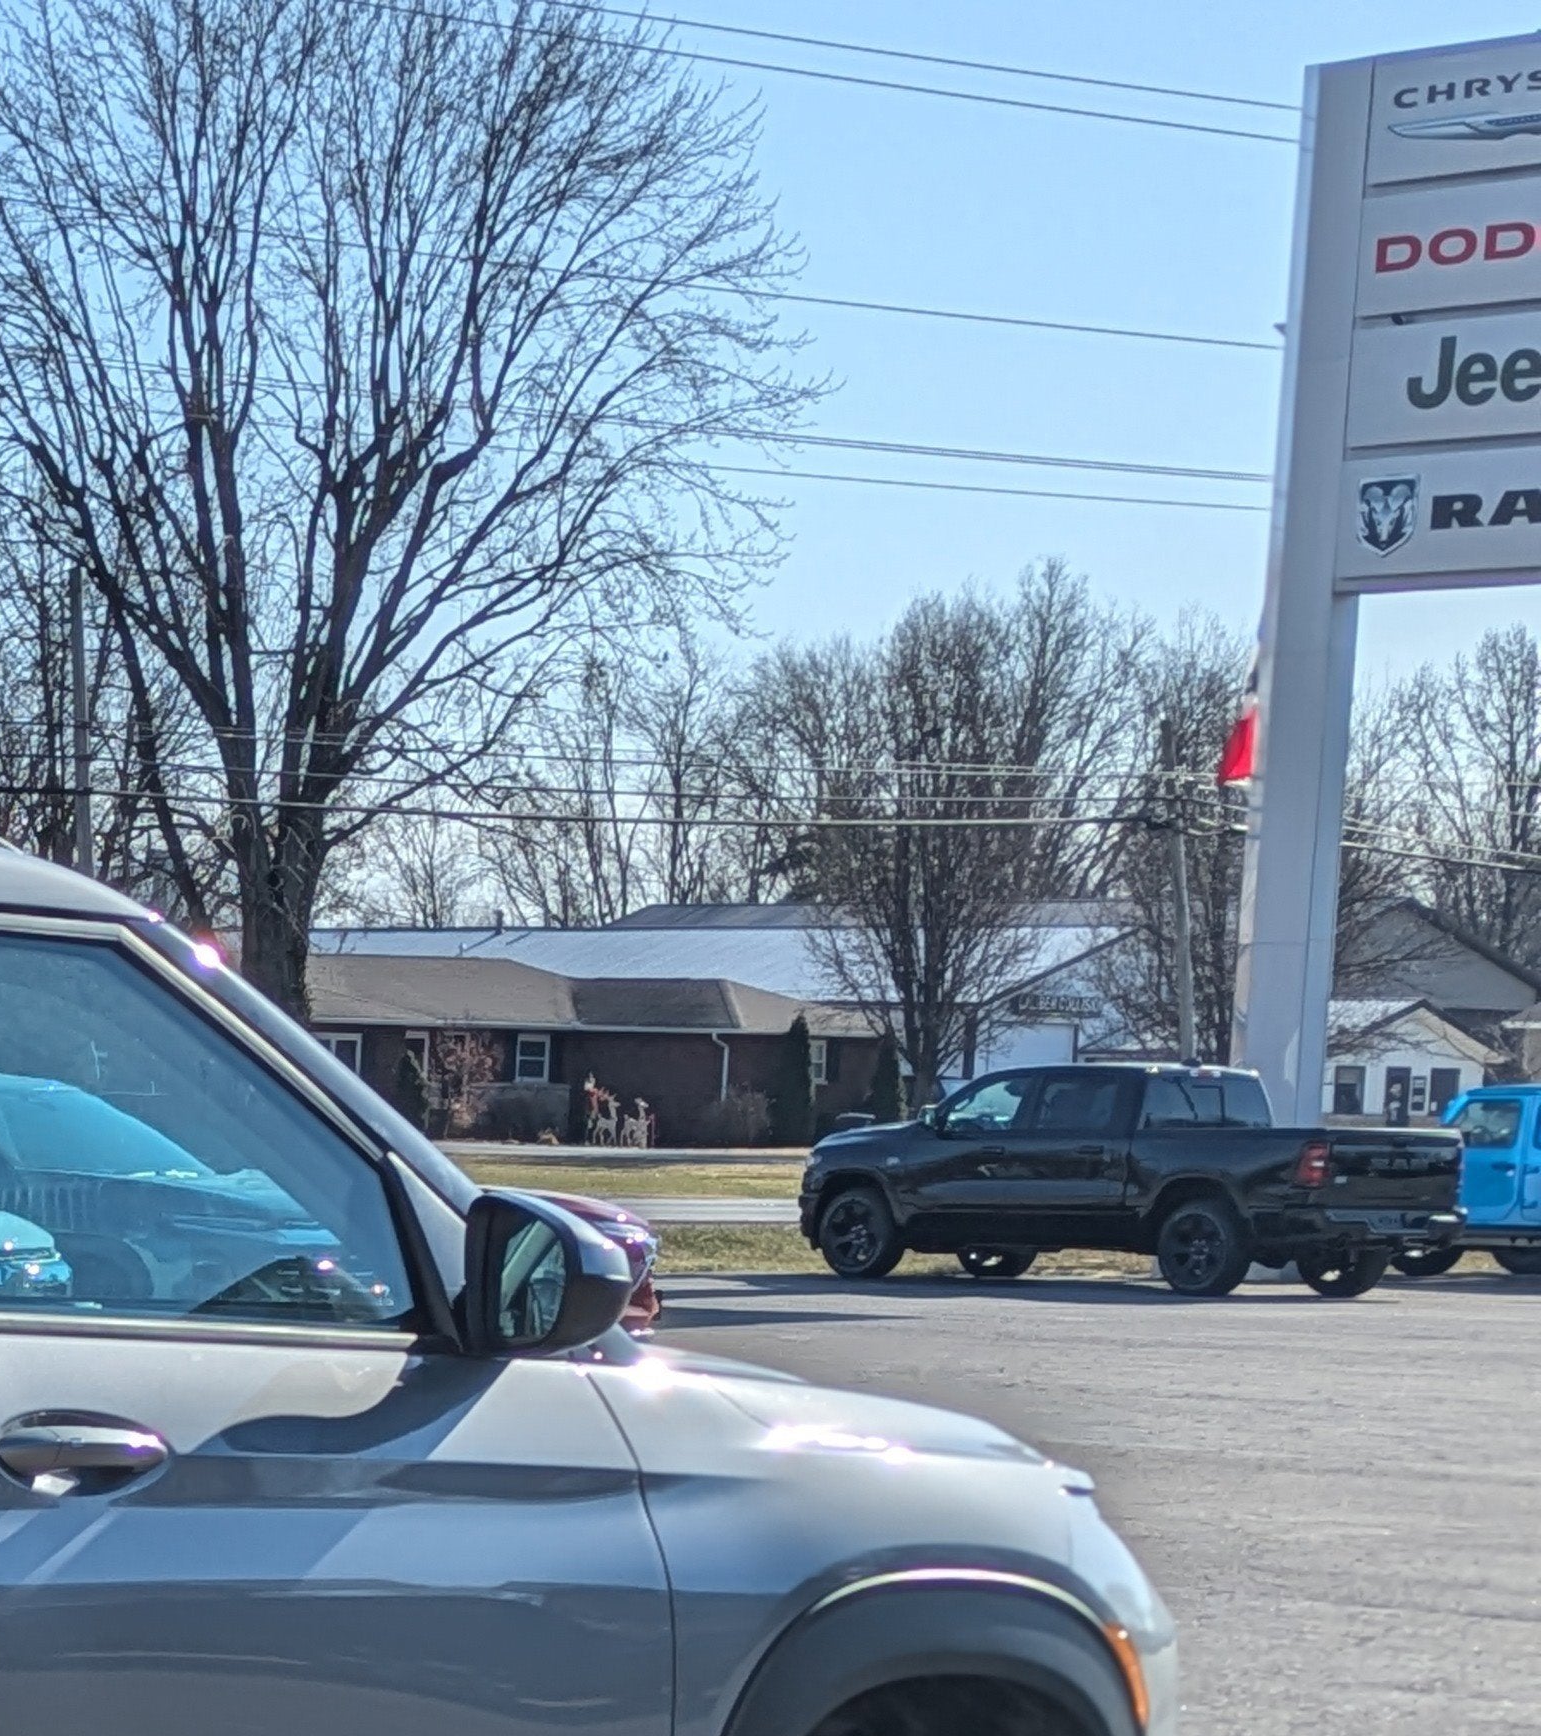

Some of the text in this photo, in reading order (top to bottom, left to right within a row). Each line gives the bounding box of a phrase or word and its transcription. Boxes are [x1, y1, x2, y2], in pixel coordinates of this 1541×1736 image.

[1375, 222, 1537, 274] DOD
[1407, 335, 1541, 410] Jee
[1430, 488, 1541, 531] RA
